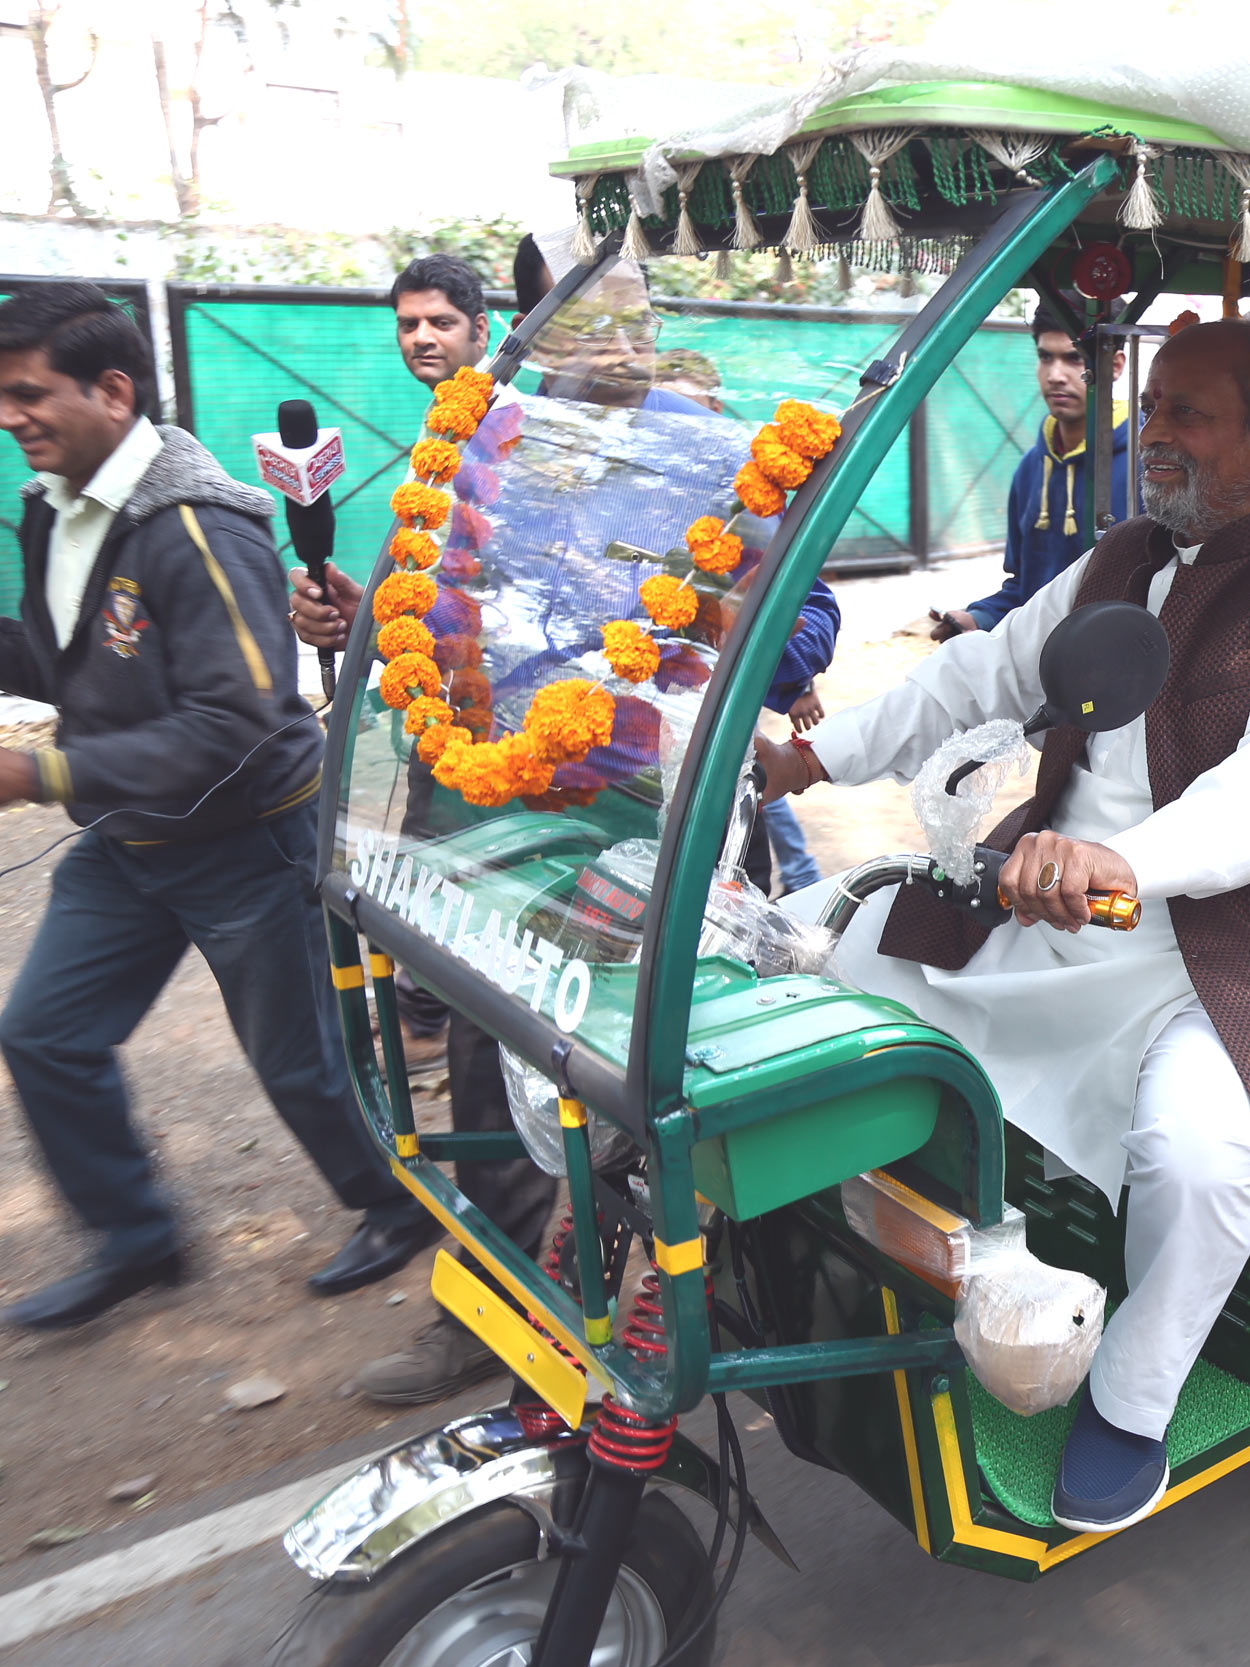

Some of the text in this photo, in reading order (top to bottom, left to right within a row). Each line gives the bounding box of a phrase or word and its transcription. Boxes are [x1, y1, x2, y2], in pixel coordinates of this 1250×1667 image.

[351, 829, 591, 1034] SHAKTI AUTO
[603, 887, 646, 919] AUTO
